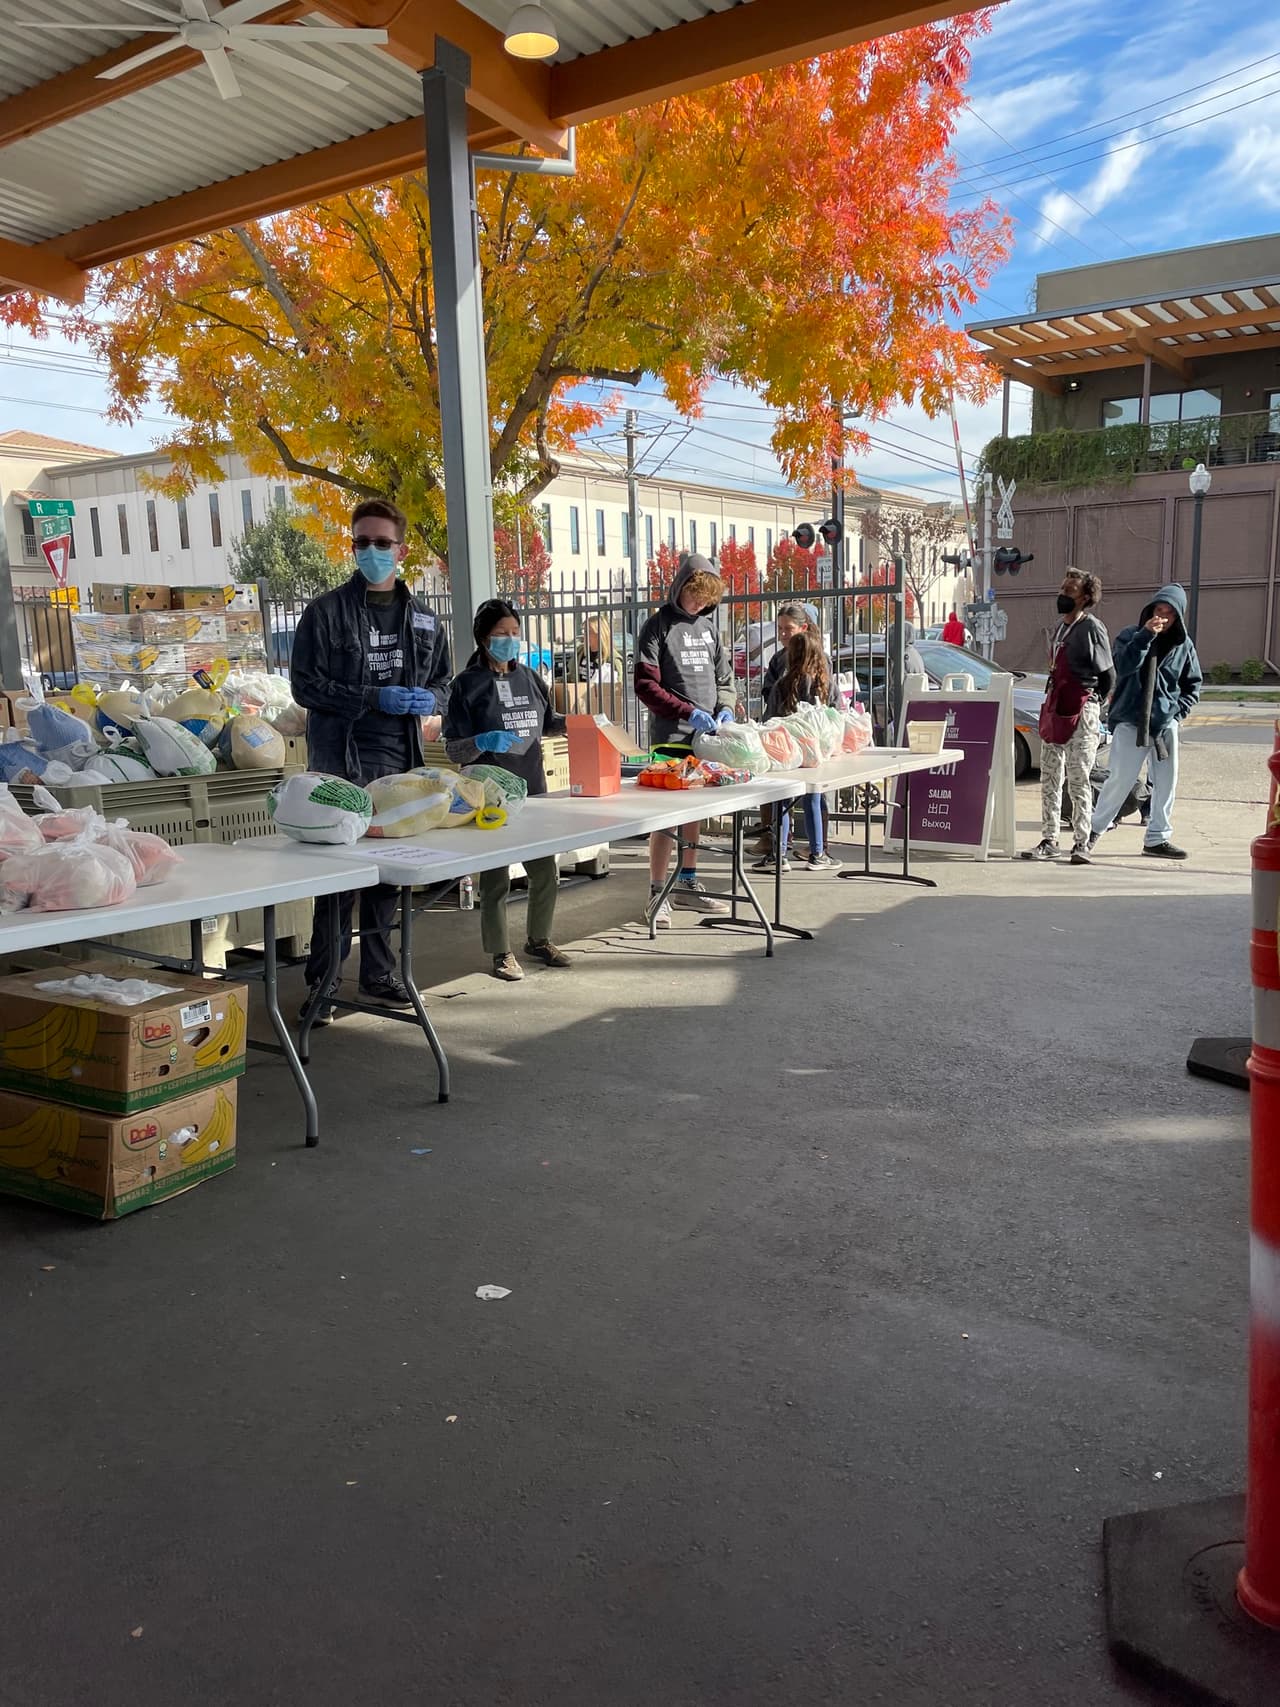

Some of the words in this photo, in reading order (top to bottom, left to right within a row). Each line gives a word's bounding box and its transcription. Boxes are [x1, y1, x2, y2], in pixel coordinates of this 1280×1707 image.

[36, 503, 44, 514] R
[369, 658, 403, 671] STRIBUTION
[502, 712, 523, 721] HOLIDAY
[525, 710, 537, 719] FOOD
[504, 719, 538, 729] DISTRIBUTION
[929, 762, 956, 775] EXIT
[928, 789, 951, 798] SALIDA
[927, 804, 949, 815] 出口
[922, 818, 951, 830] Выход
[144, 1023, 171, 1039] Dole
[130, 1124, 157, 1142] Dole
[116, 1186, 150, 1206] BANANAS
